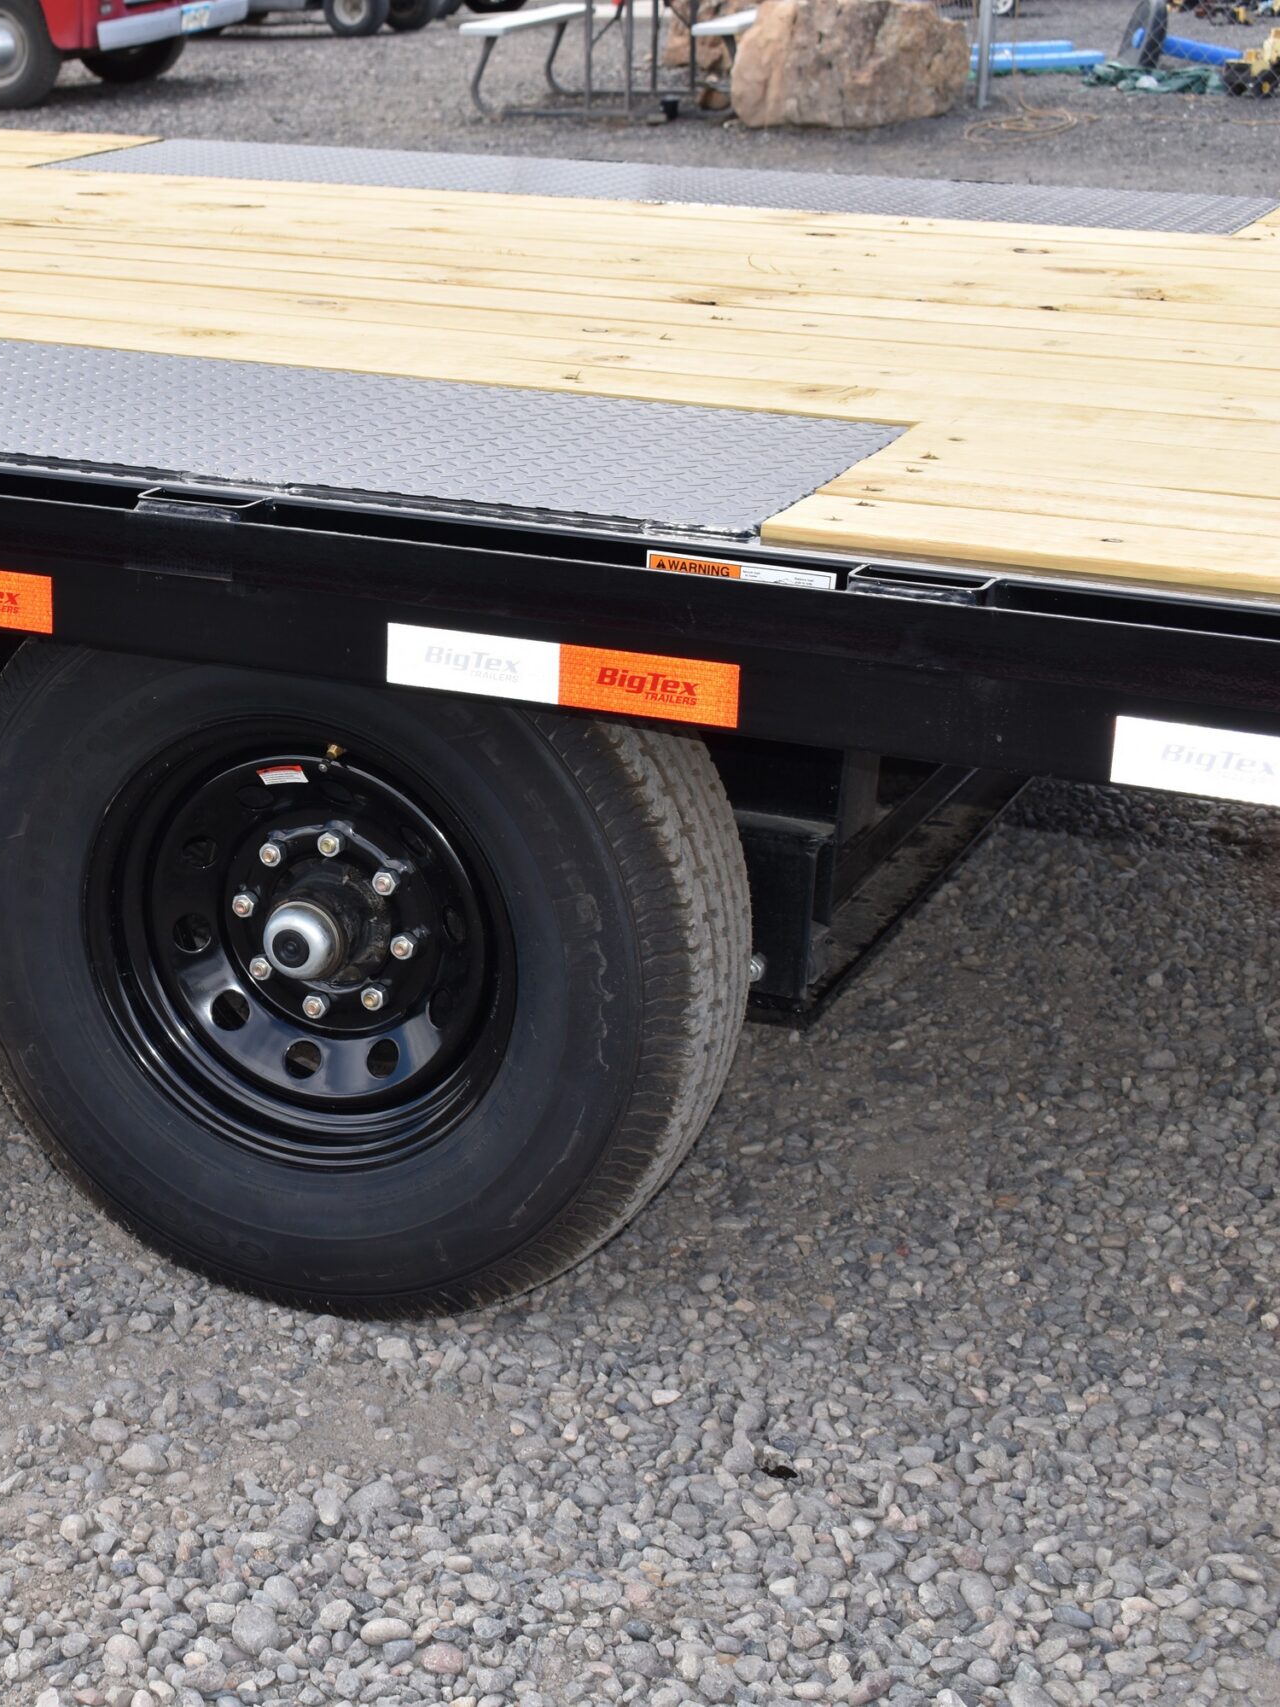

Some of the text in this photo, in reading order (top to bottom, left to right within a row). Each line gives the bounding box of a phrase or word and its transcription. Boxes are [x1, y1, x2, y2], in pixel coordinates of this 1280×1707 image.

[668, 560, 730, 577] WARNING
[424, 645, 521, 674] BigTex
[470, 670, 520, 683] TRAILERS
[595, 666, 700, 697] BigTex
[644, 691, 698, 706] TRAILERS
[1160, 743, 1276, 777] BigTex
